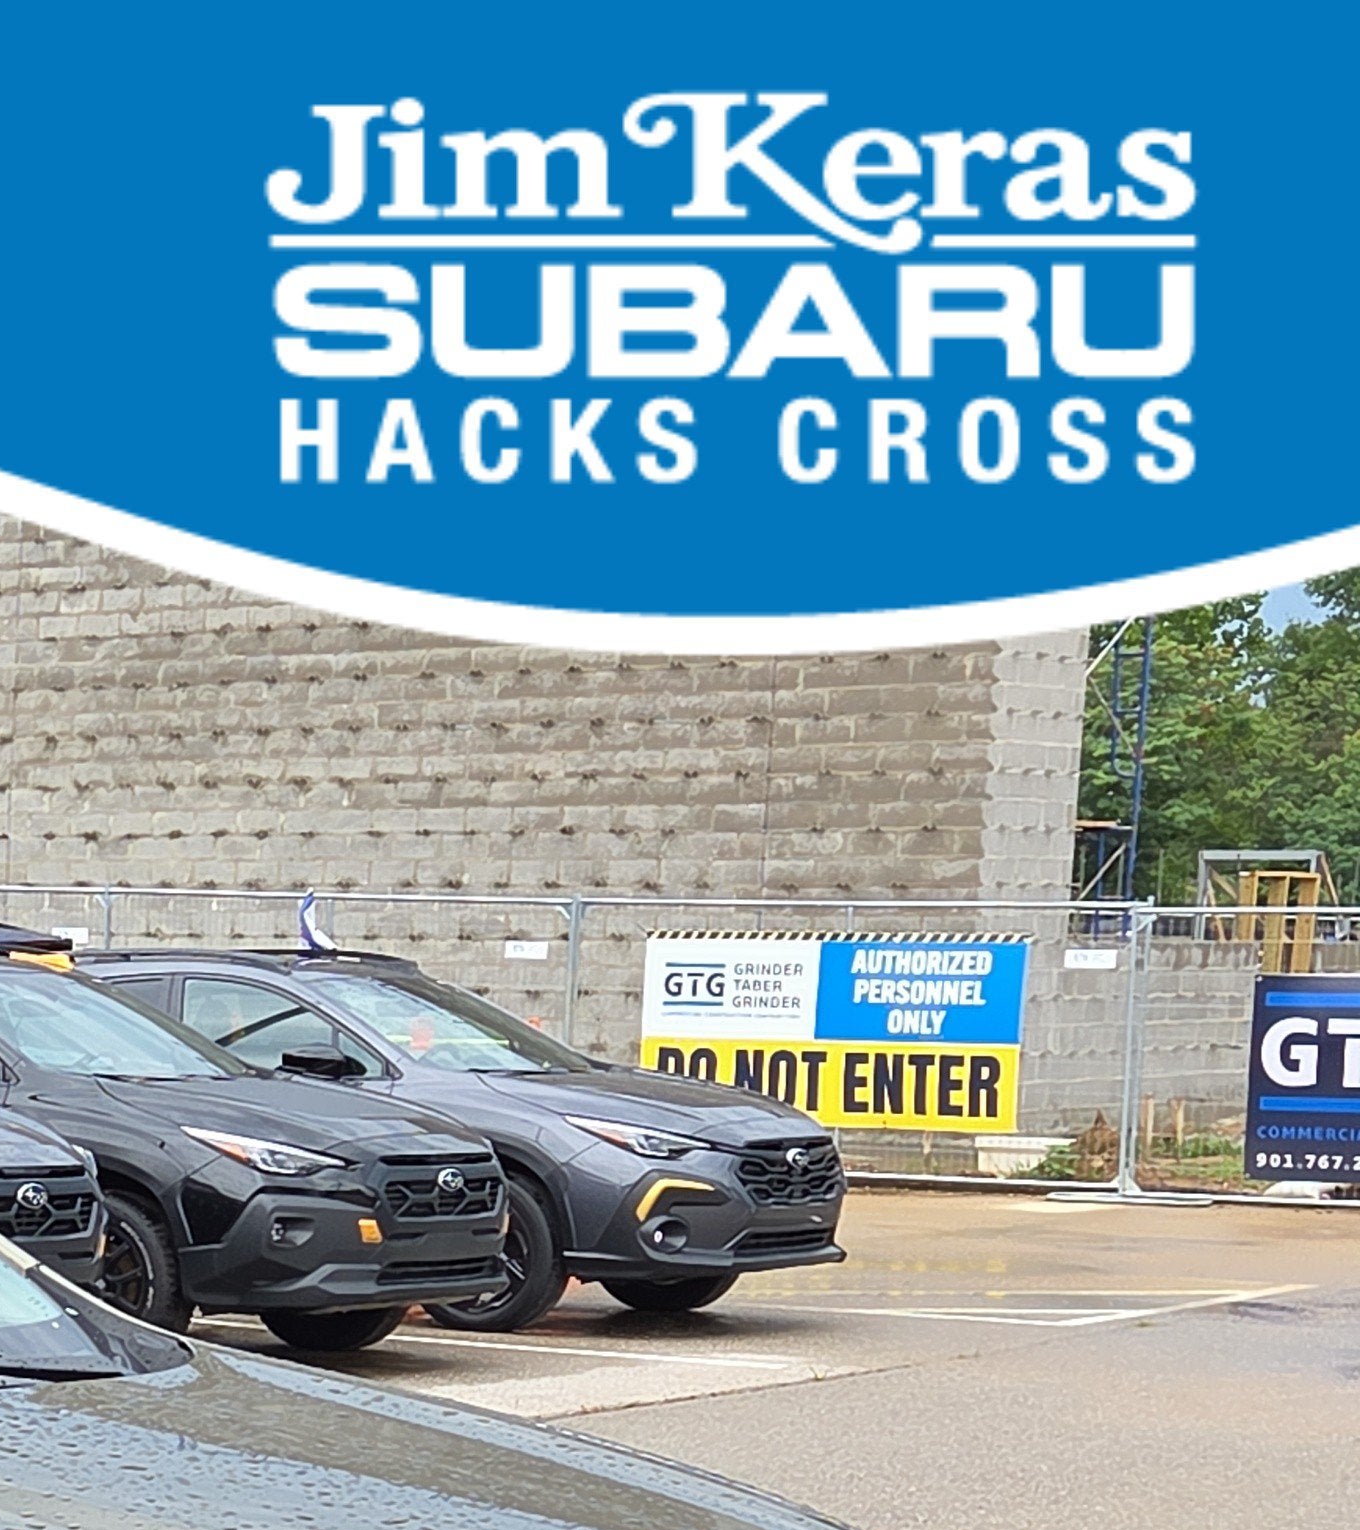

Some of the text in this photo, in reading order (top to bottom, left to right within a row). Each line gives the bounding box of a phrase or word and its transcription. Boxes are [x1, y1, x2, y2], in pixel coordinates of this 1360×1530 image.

[734, 963, 803, 976] GRINDER
[851, 949, 993, 976] AUTHORIZED
[664, 973, 726, 997] GTG
[734, 979, 782, 992] TABER
[853, 979, 986, 1005] PERSONNEL
[732, 995, 801, 1009] GRINDER
[887, 1009, 947, 1035] ONLY
[733, 1049, 828, 1111] NOT
[843, 1052, 1001, 1117] ENTER
